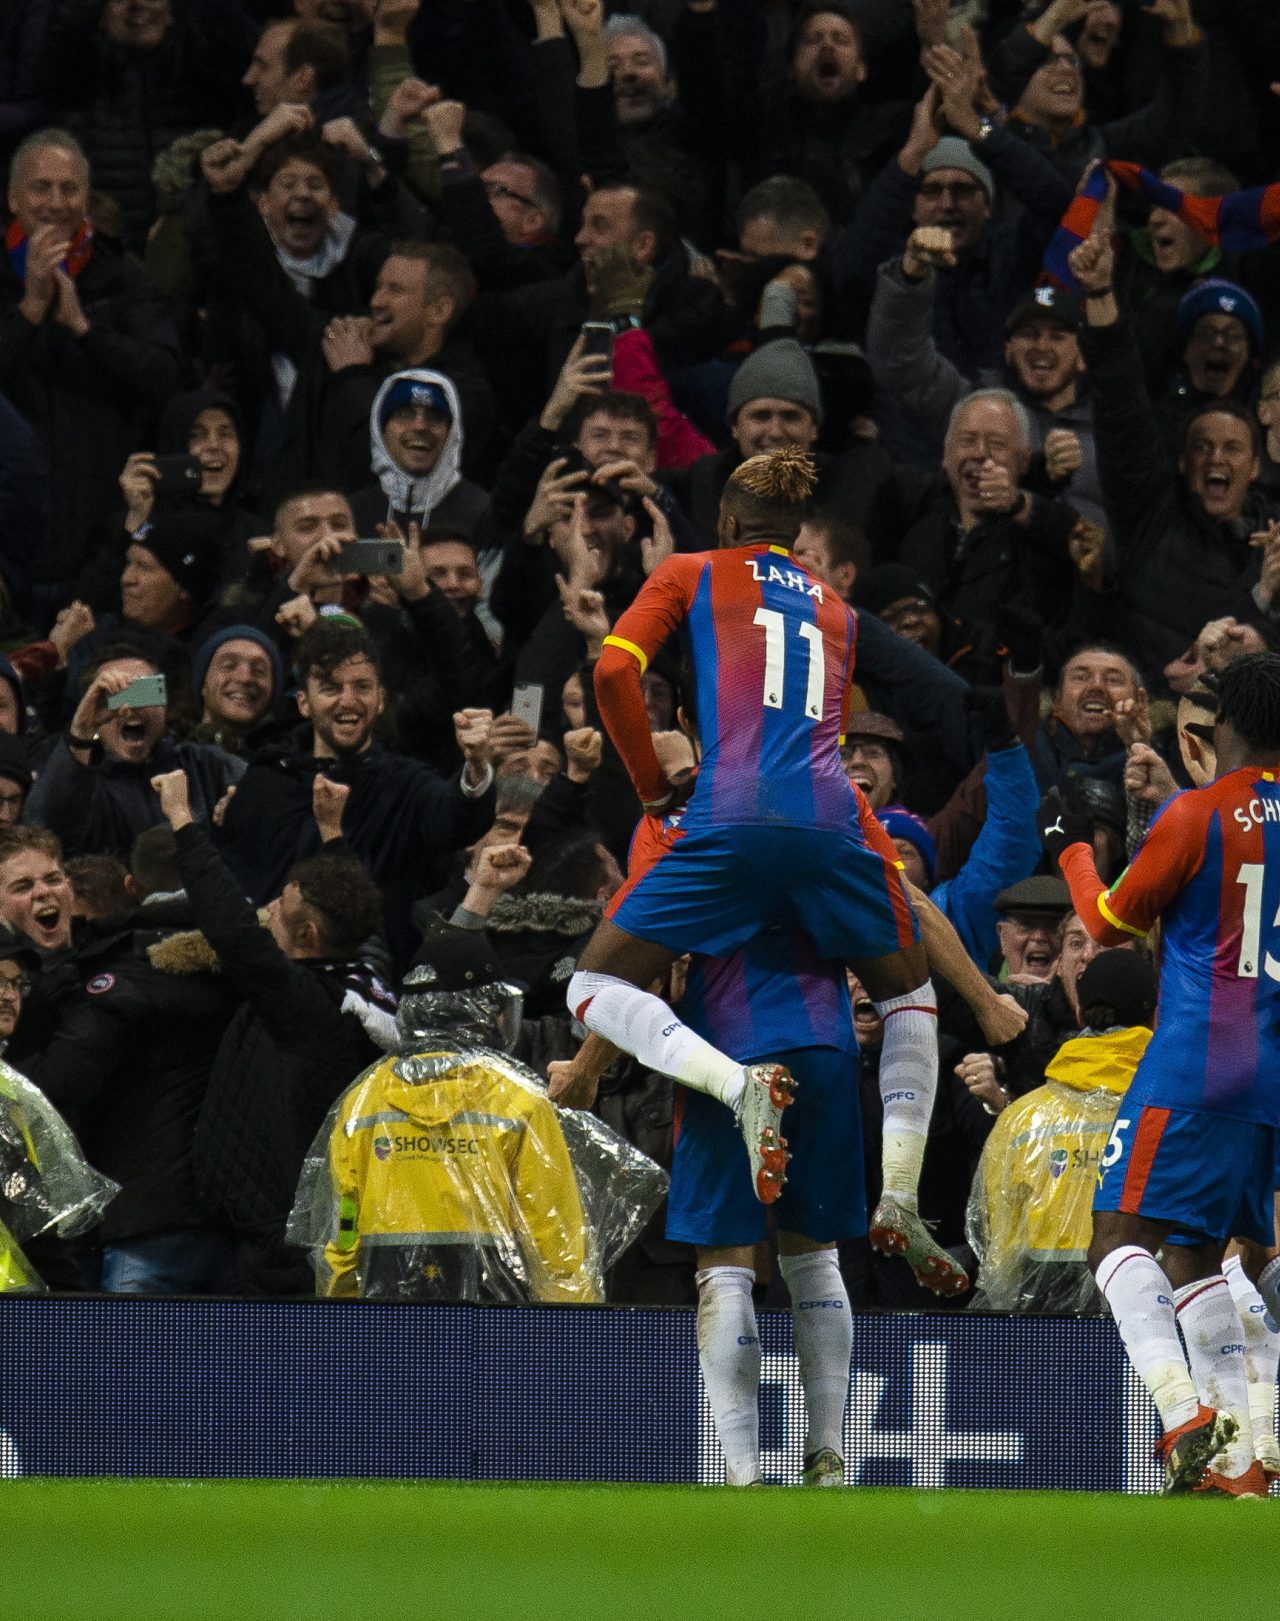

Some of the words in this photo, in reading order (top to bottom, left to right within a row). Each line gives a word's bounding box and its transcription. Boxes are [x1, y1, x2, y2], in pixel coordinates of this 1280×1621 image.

[745, 560, 823, 604] ZAHA
[753, 607, 825, 722] 11
[883, 1091, 915, 1104] CPFC
[799, 1300, 843, 1310] CPFC
